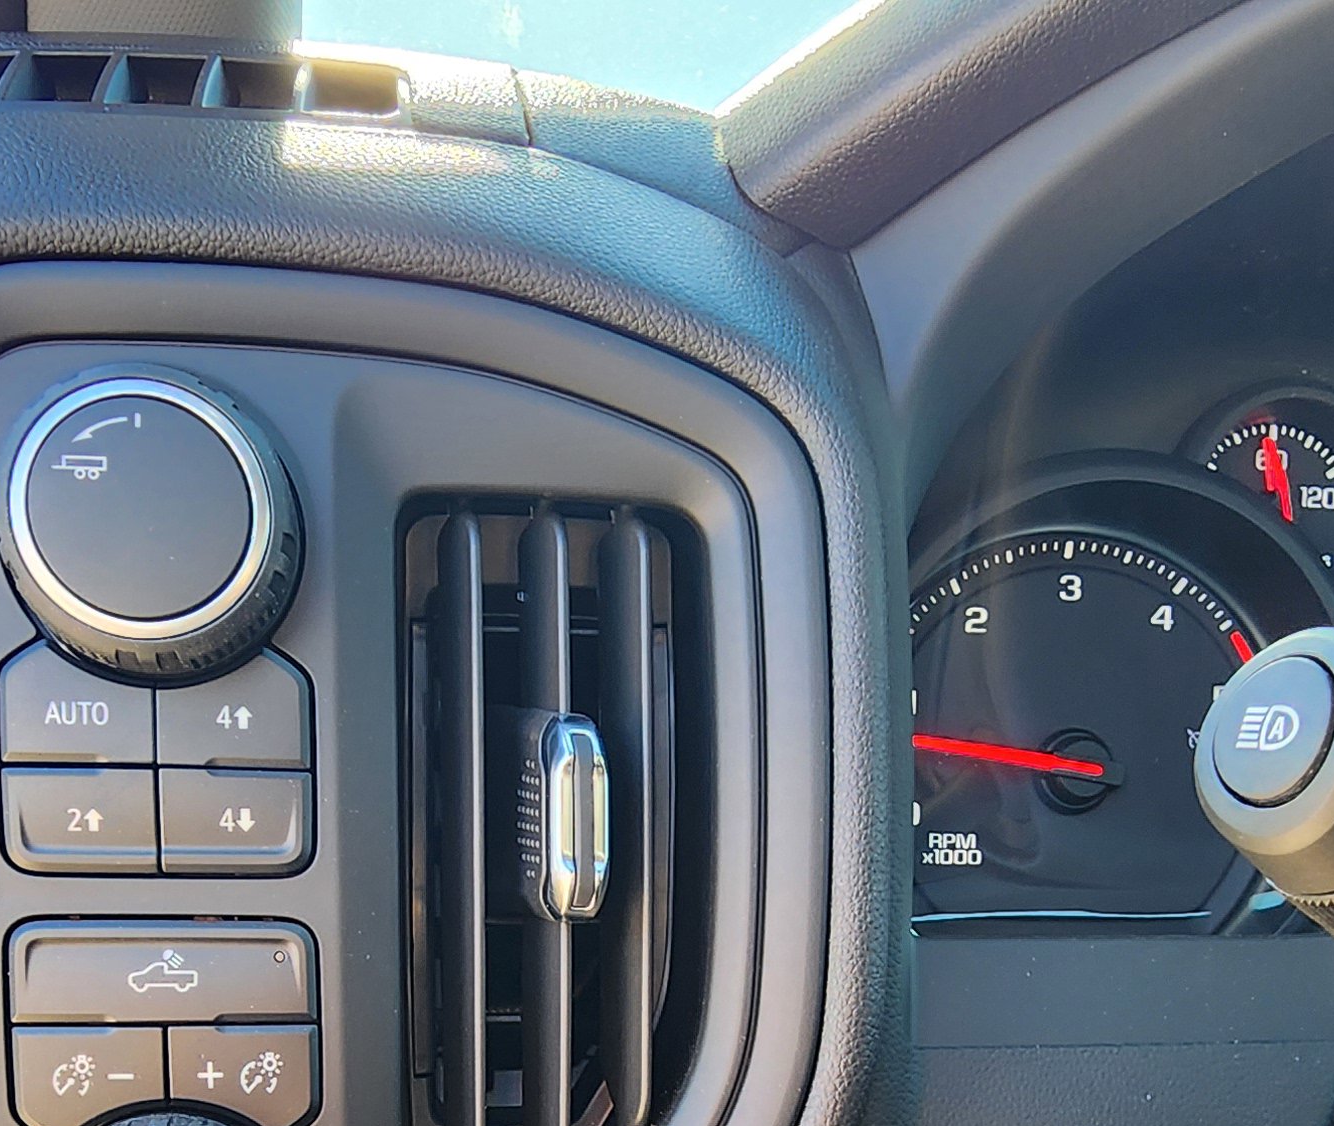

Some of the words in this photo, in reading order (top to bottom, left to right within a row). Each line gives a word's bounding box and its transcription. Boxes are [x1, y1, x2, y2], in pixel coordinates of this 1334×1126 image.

[1059, 574, 1082, 601] 3
[964, 606, 989, 633] 2
[1150, 605, 1174, 631] 4
[44, 701, 109, 726] AUTO
[215, 705, 233, 730] 4
[66, 807, 86, 832] 2
[219, 807, 236, 832] 4
[928, 832, 977, 849] RPM
[922, 849, 982, 865] x1000
